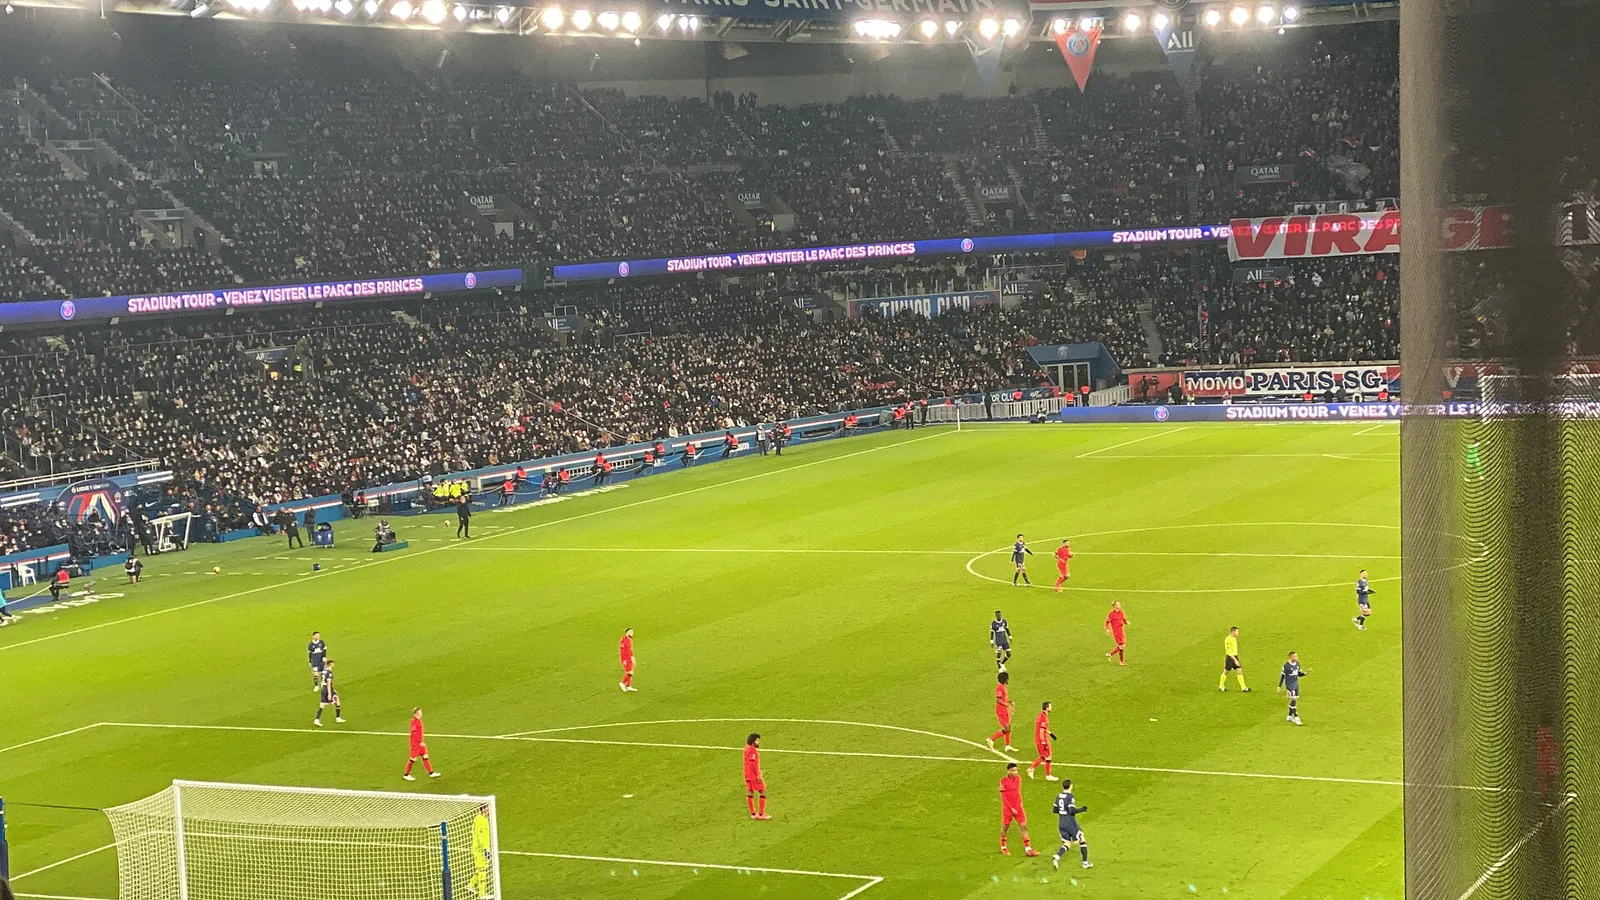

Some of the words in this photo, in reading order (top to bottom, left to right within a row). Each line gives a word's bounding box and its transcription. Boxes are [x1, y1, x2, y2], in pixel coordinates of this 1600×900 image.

[1250, 167, 1280, 177] QATAR
[737, 193, 761, 203] QATAR
[981, 187, 1009, 197] QATAR
[470, 196, 494, 206] QATAR
[1113, 230, 1167, 243] STADIUM
[1168, 228, 1203, 240] TOUR
[667, 259, 708, 272] STADIUM
[707, 256, 732, 268] TOUR
[737, 252, 767, 266] VENEZ
[766, 250, 805, 264] VISITER
[805, 249, 818, 261] LE
[818, 248, 845, 260] PARC
[845, 246, 867, 258] DES
[867, 242, 916, 256] PRINCES
[128, 295, 182, 313] STADIUM
[181, 293, 216, 309] TOUR
[222, 288, 263, 305] VENEZ
[262, 286, 308, 303] VISITER
[308, 285, 323, 300] LE
[322, 283, 354, 299] PARC
[354, 281, 376, 296] DES
[376, 278, 424, 295] PRINCES
[1187, 376, 1245, 391] MOMO
[1251, 370, 1336, 391] PARIS
[1343, 369, 1382, 390] SG
[1226, 405, 1288, 419] STADIUM
[1288, 405, 1329, 418] TOUR
[1338, 405, 1387, 418] VENEZ
[1058, 798, 1065, 811] 9
